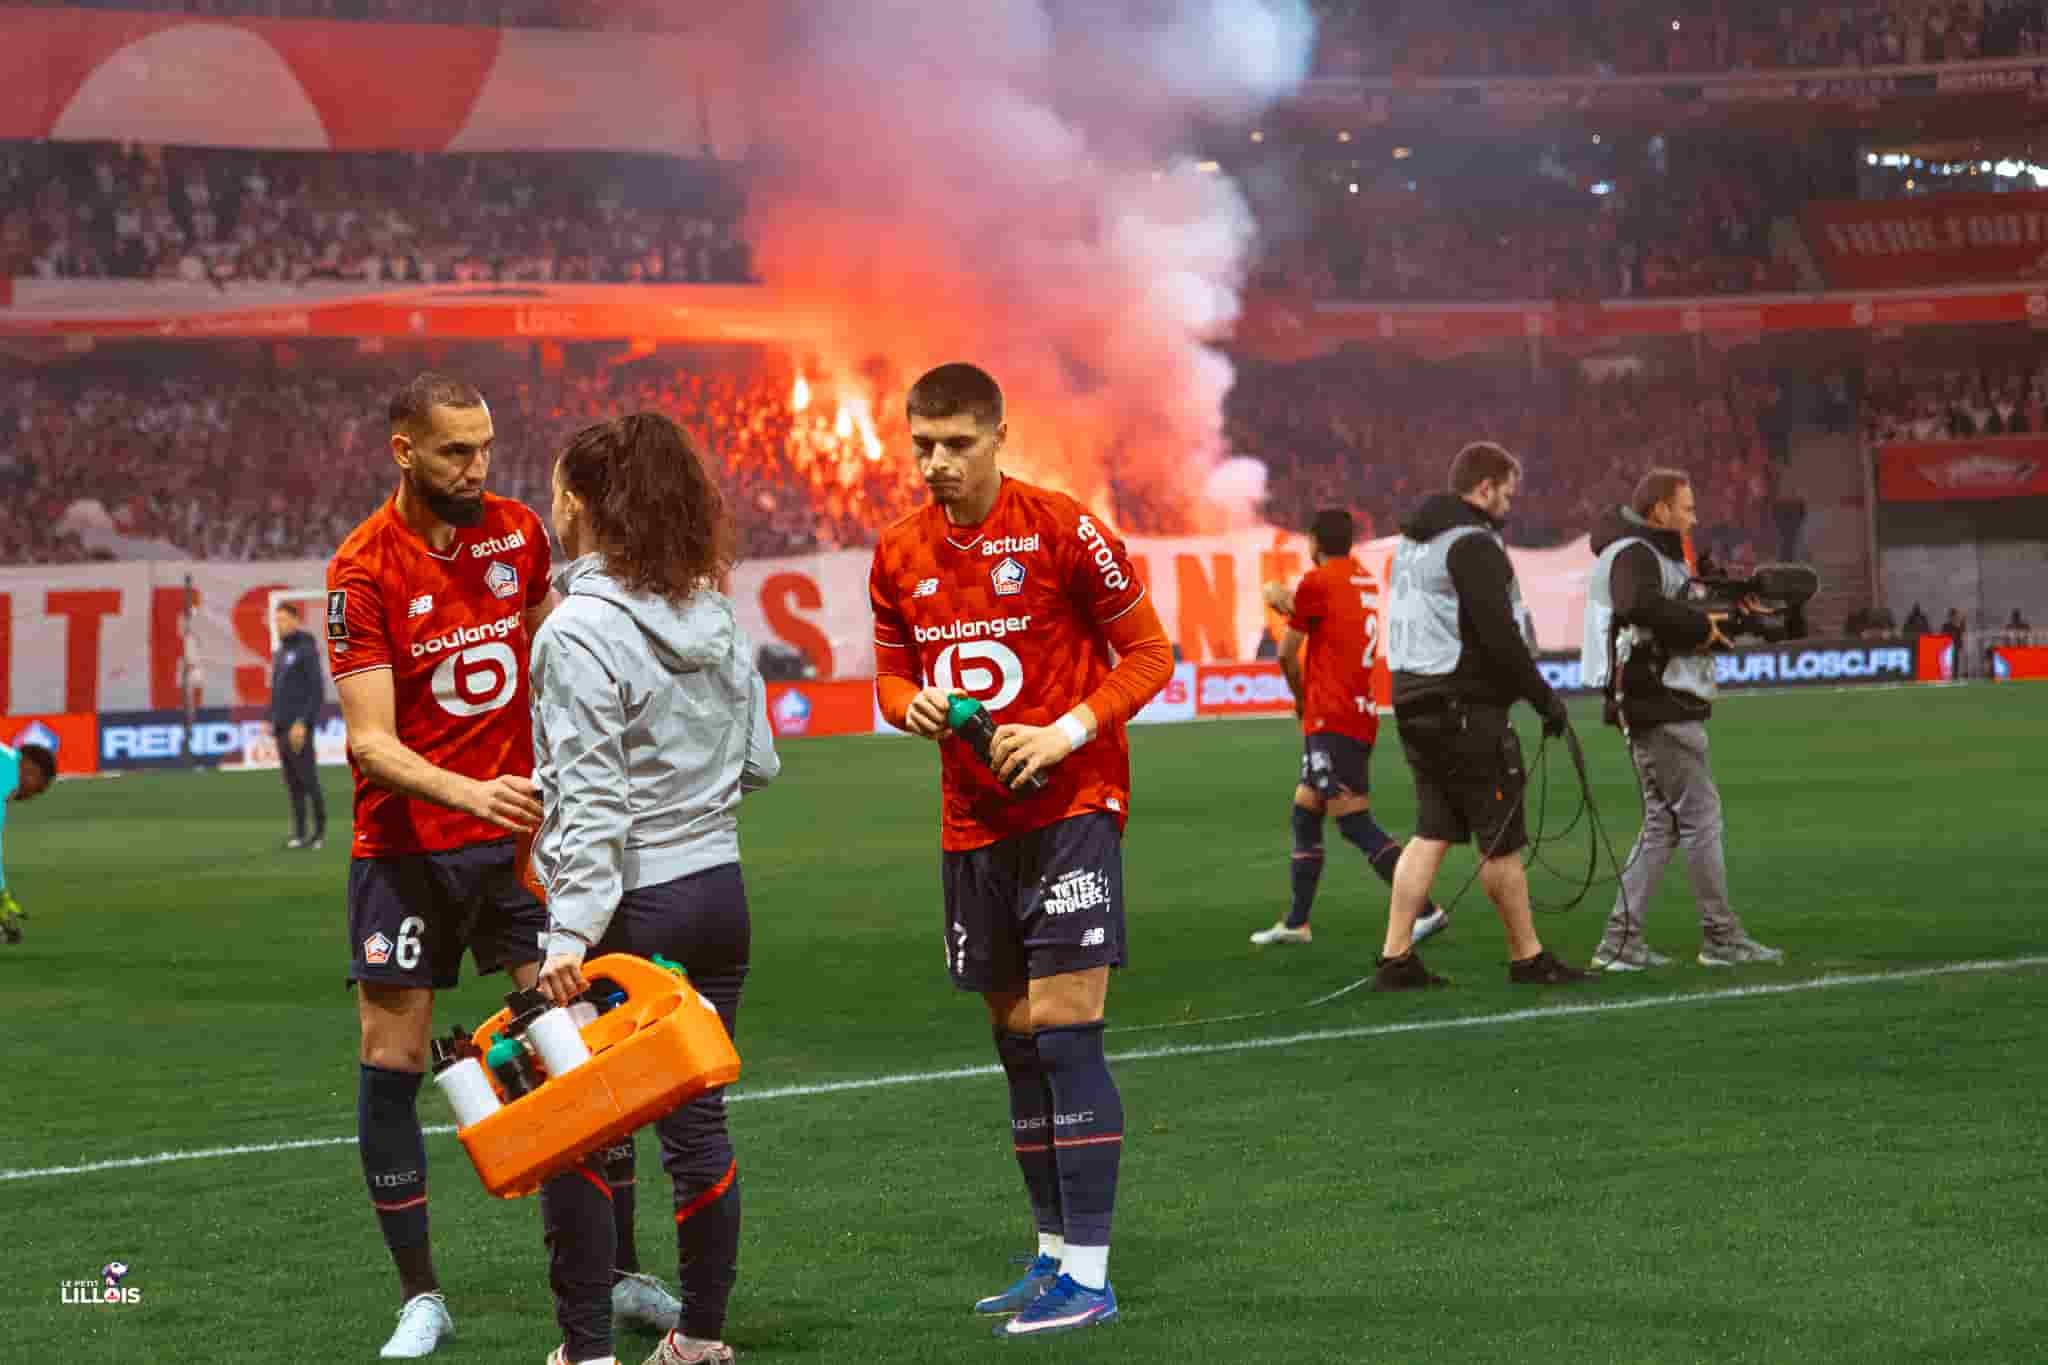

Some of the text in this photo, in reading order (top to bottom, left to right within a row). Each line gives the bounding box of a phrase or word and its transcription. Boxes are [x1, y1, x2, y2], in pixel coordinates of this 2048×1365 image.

[471, 529, 526, 558] actual
[982, 533, 1039, 555] actual
[411, 611, 520, 657] boulanger
[914, 614, 1032, 643] boulanger
[1715, 655, 1776, 684] SUR
[1779, 647, 1910, 679] LOSC.FR
[396, 916, 424, 969] 6
[375, 1169, 418, 1188] LOSC
